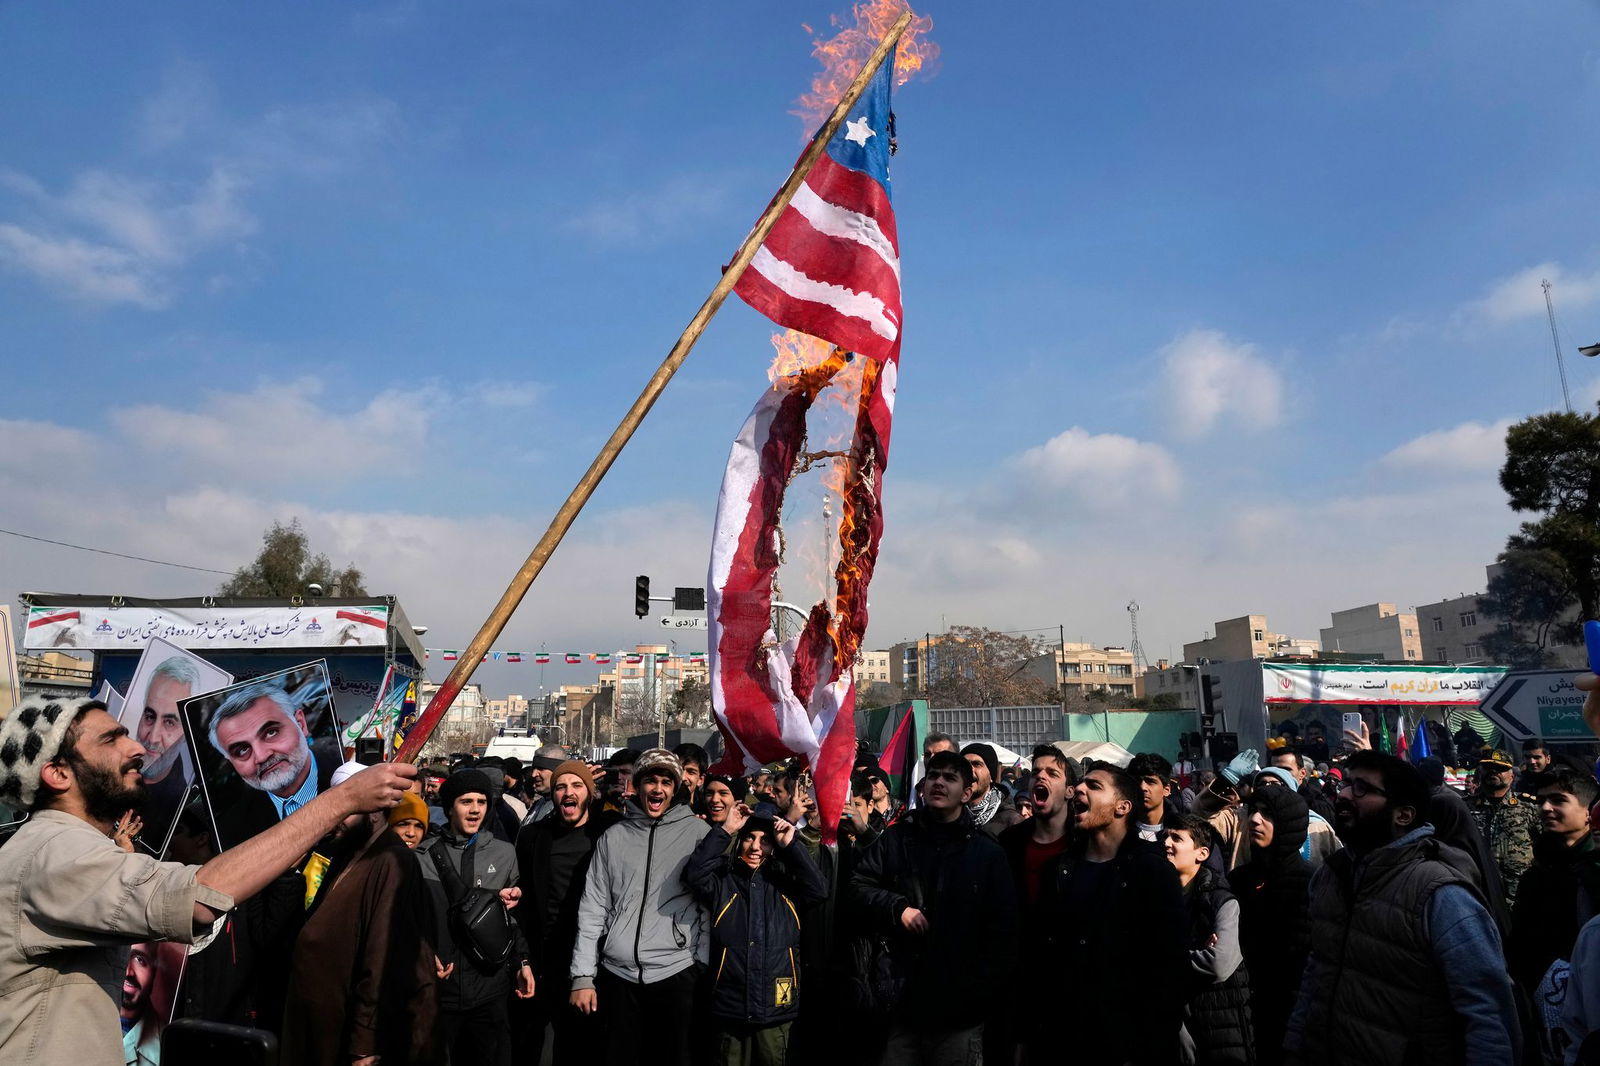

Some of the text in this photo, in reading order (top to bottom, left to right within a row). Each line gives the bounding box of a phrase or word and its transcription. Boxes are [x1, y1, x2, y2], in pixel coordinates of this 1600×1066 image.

[142, 616, 162, 639] نفتی
[207, 617, 228, 639] پخش
[259, 623, 269, 638] ملی
[271, 611, 301, 638] شرکت
[675, 618, 699, 628] آزادی
[117, 626, 141, 642] ایران
[233, 619, 258, 644] پالایش
[1390, 680, 1415, 694] کریم
[1417, 678, 1439, 694] قرآن
[1440, 680, 1450, 690] ما
[1452, 680, 1484, 694] انقلاب
[1548, 709, 1581, 720] چمران
